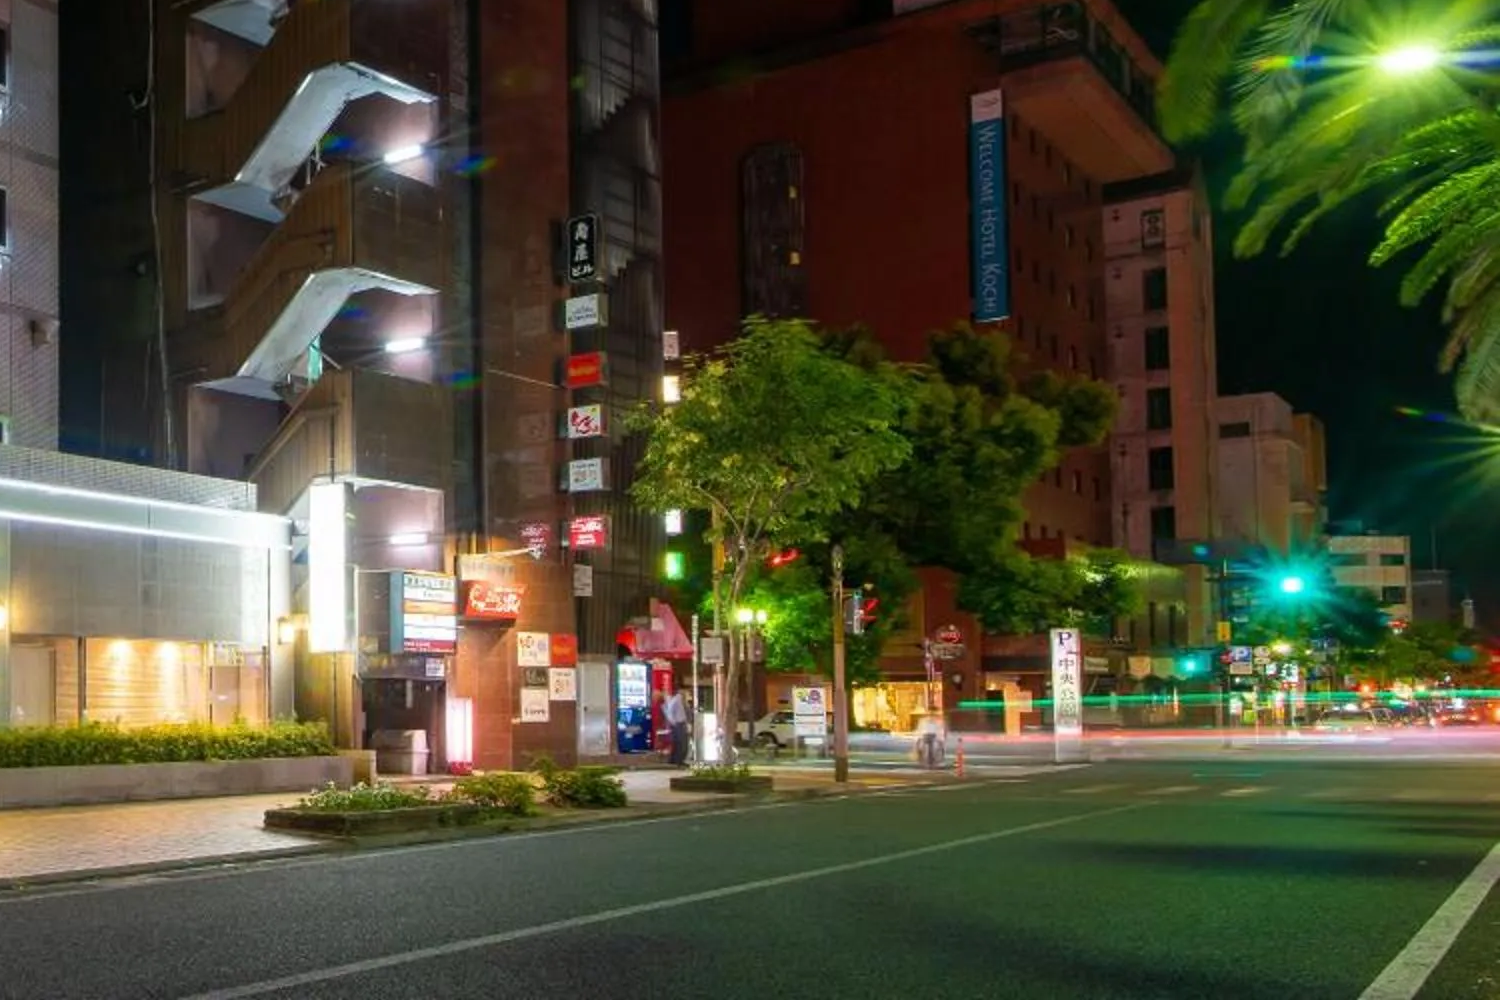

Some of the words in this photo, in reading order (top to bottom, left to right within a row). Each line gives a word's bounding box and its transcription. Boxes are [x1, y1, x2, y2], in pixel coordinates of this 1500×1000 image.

[980, 209, 997, 258] HOTEL
[981, 263, 1002, 313] KOCHI
[1058, 631, 1072, 646] P
